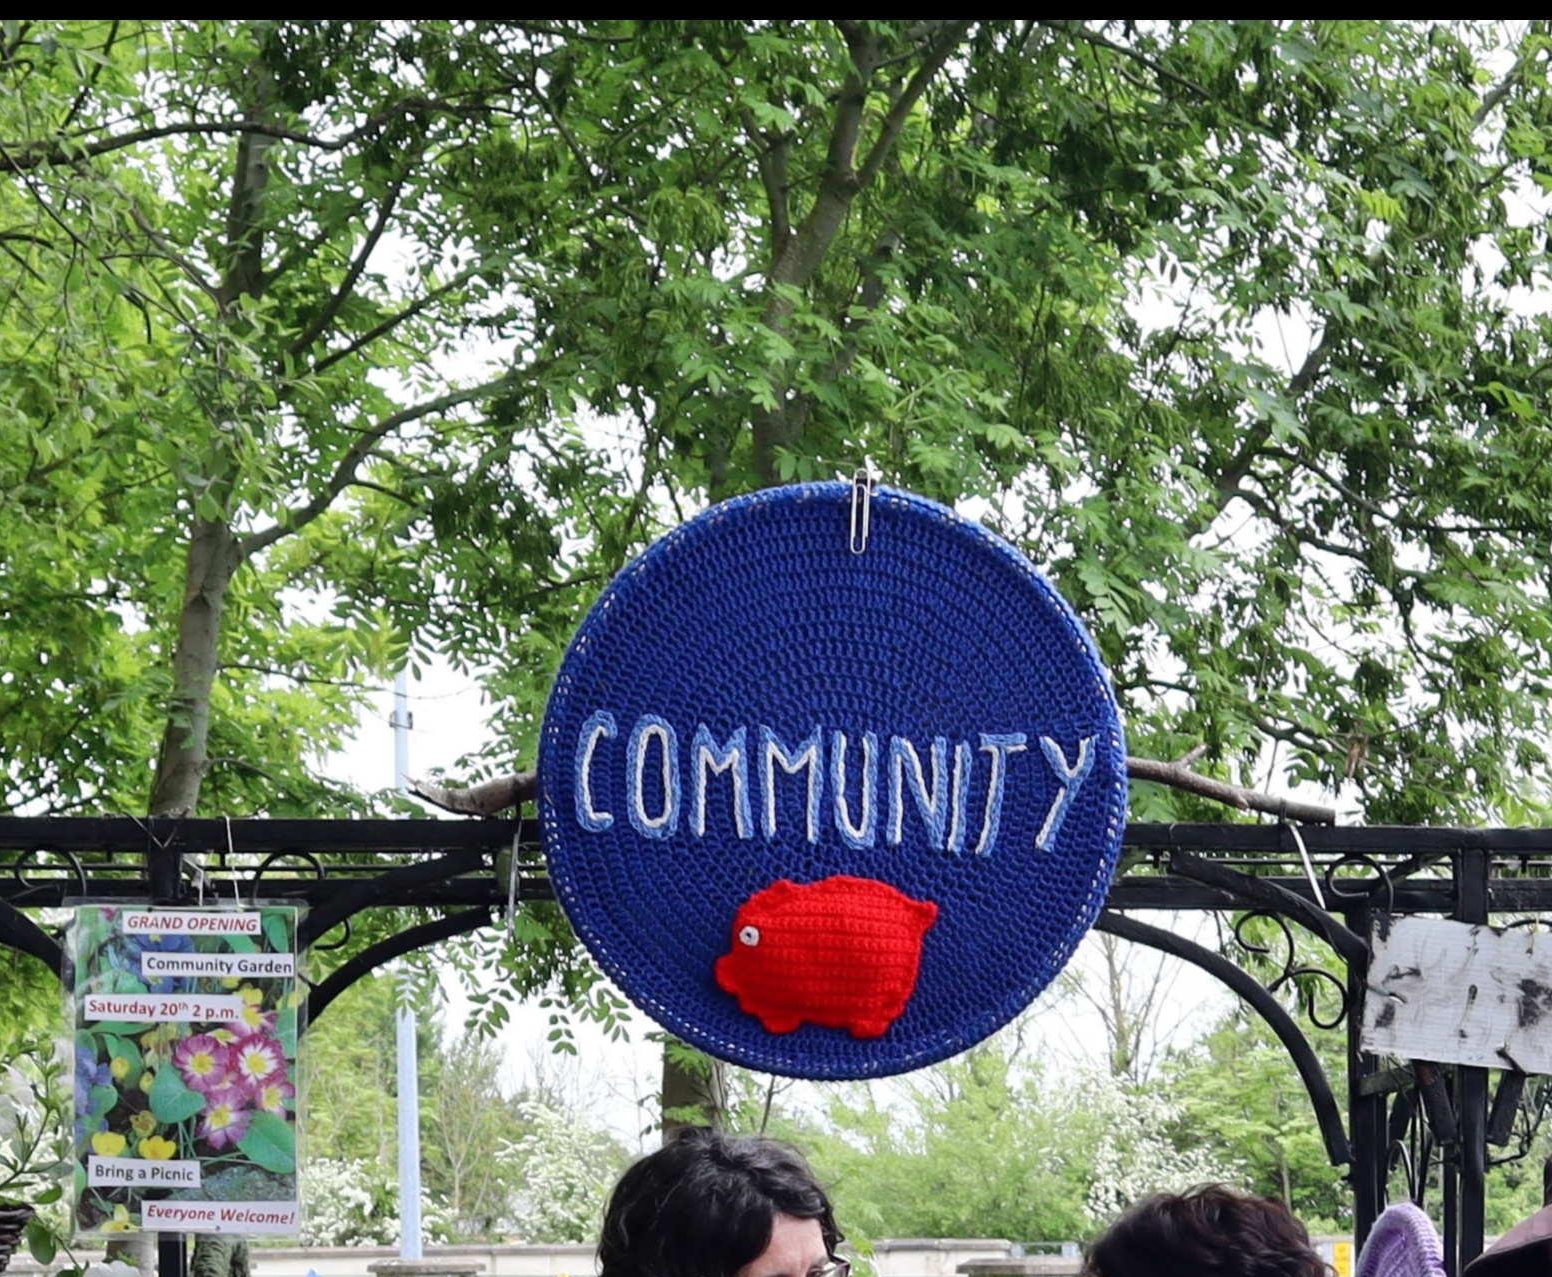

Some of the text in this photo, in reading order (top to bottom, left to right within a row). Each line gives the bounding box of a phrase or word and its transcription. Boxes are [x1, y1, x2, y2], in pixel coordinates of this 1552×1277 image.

[574, 710, 1100, 857] COMMUNITY
[128, 915, 258, 931] GRAND OPENING
[147, 956, 293, 974] Community Garden
[88, 999, 239, 1021] Saturday 20th 2 p.m.
[95, 1164, 194, 1182] Bring a Picnic
[147, 1204, 295, 1225] Everyone Welcome!
